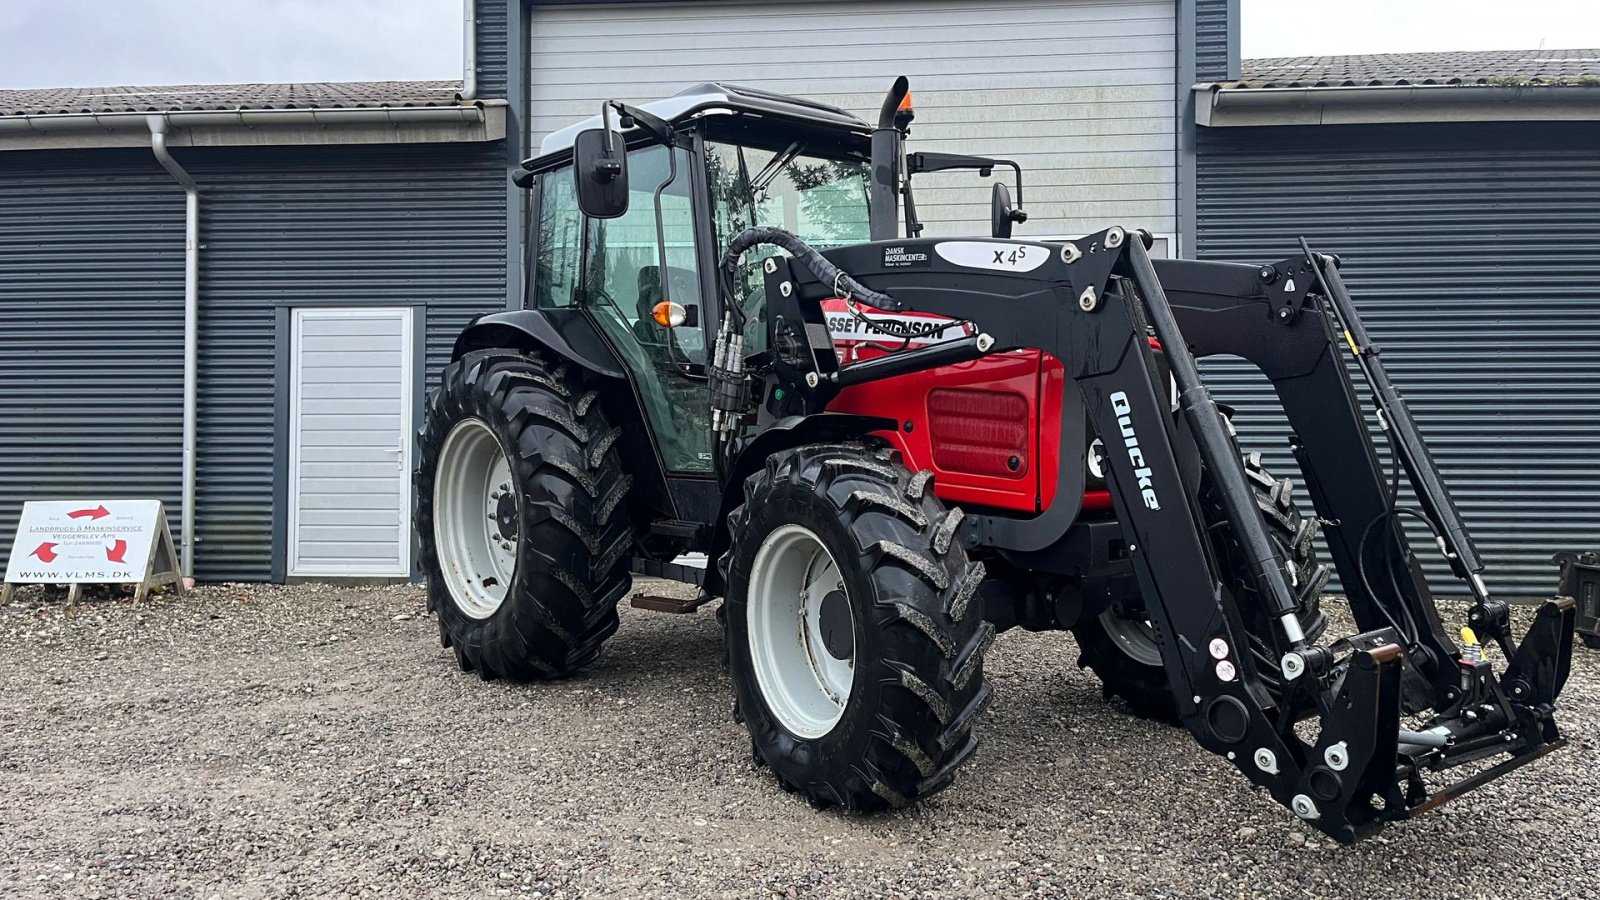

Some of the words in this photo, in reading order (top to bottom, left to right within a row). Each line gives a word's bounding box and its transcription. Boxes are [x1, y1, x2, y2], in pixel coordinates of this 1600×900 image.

[884, 247, 905, 255] DANSK
[826, 316, 862, 333] SSEY
[1110, 391, 1161, 511] Quicke
[19, 571, 132, 579] WWW.VLMS.DK
